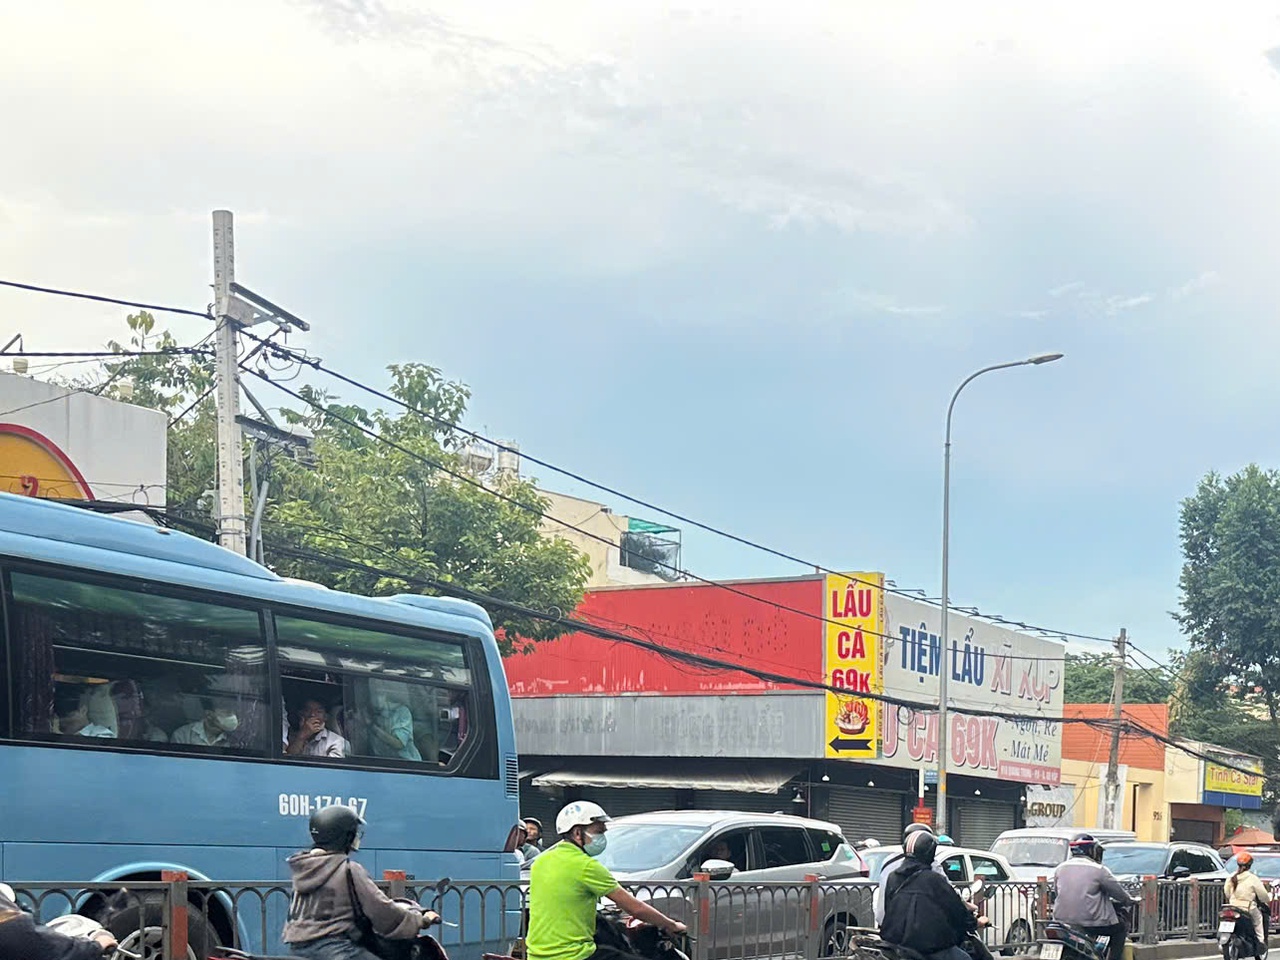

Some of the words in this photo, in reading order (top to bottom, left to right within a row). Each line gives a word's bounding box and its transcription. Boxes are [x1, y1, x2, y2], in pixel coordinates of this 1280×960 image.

[832, 578, 872, 618] LẨU
[837, 624, 866, 659] CÁ
[951, 627, 985, 687] LẨU
[831, 668, 871, 693] 69K
[951, 713, 998, 771] 69K
